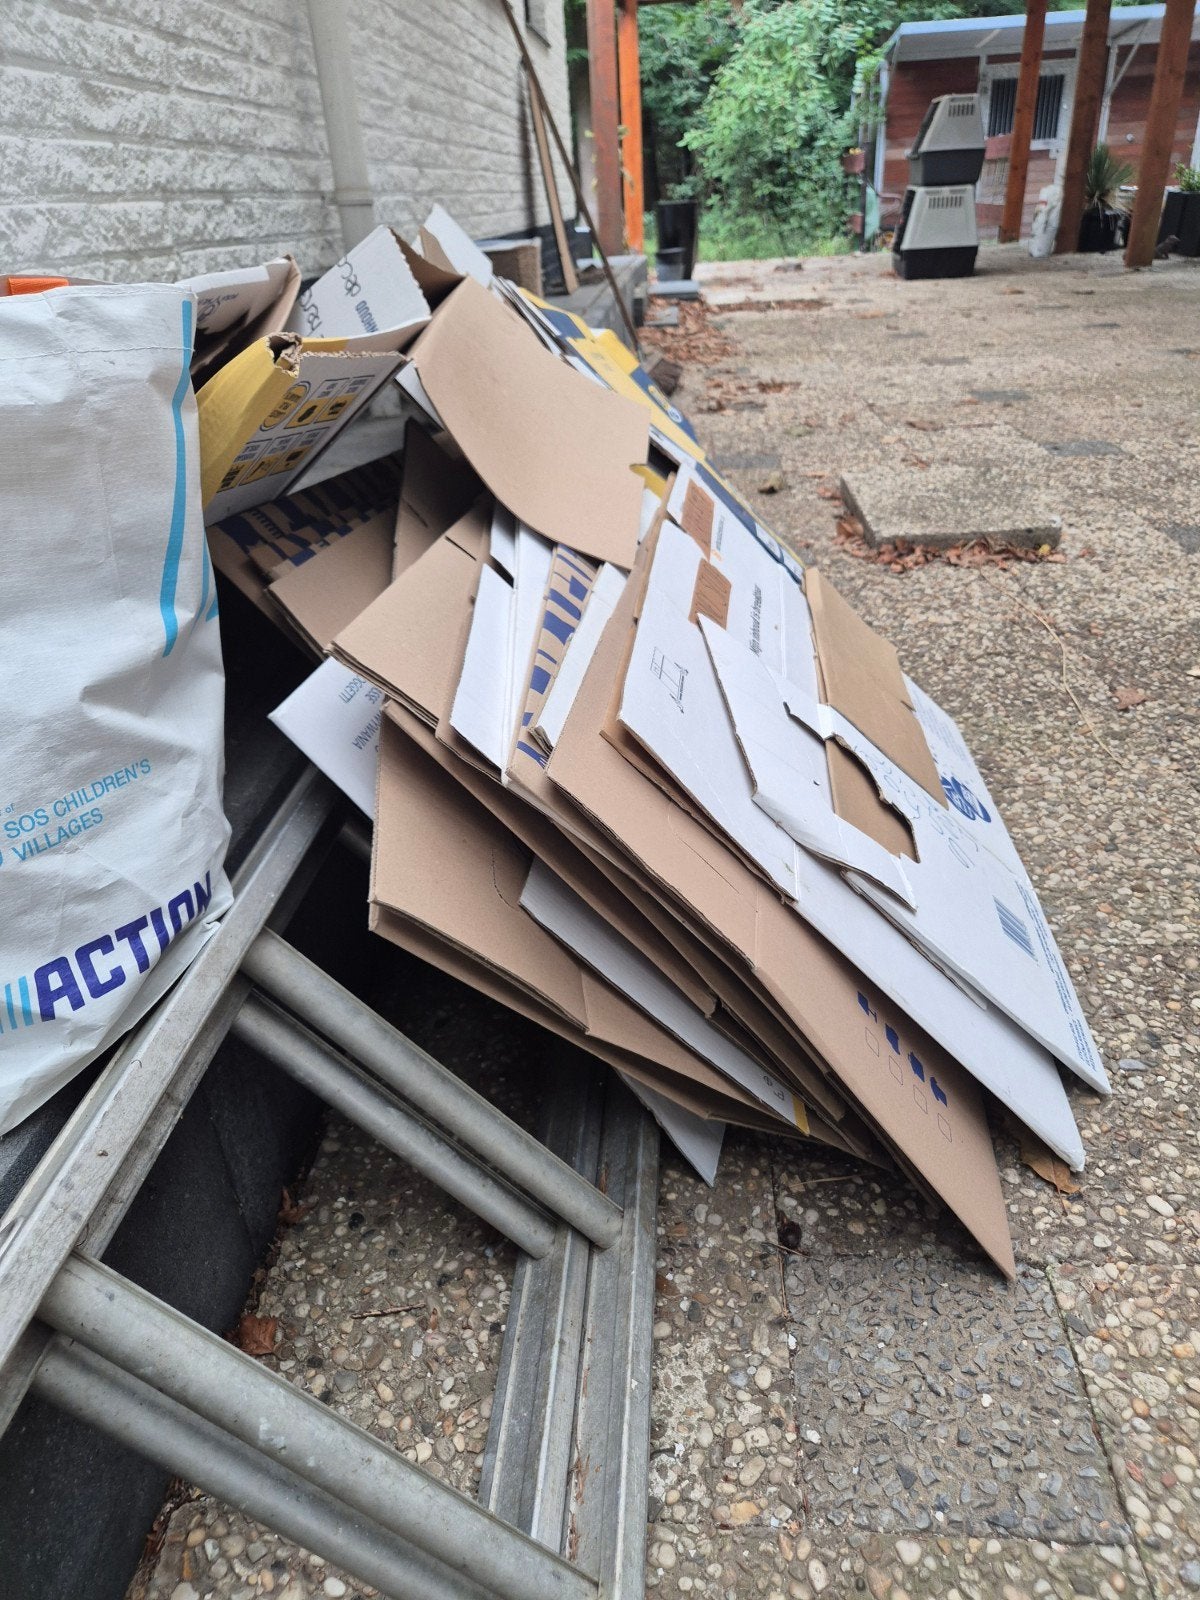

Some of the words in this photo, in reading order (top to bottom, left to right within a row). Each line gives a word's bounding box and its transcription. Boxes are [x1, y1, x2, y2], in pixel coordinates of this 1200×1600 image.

[3, 807, 50, 839] SOS
[52, 758, 151, 818] CHILDREN'S
[5, 802, 16, 814] of
[11, 807, 104, 861] VILLAGES
[33, 870, 212, 1023] ACTION
